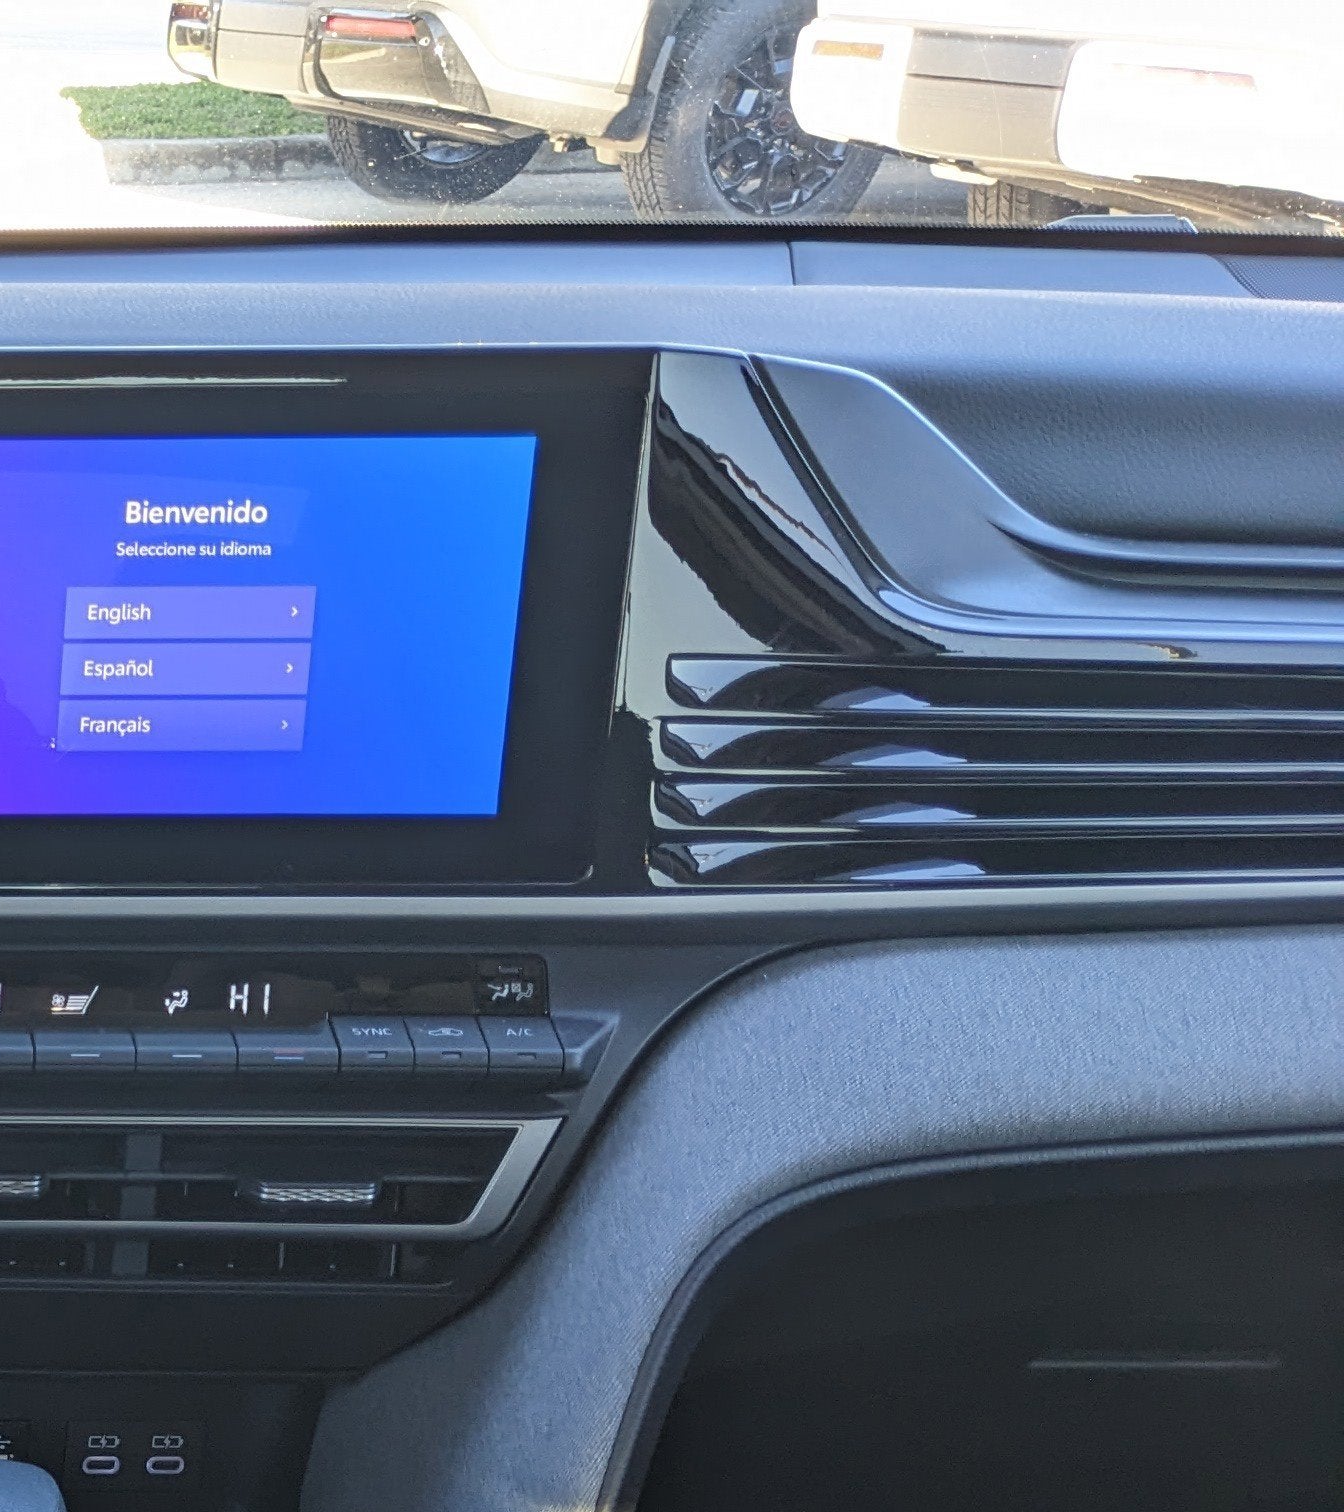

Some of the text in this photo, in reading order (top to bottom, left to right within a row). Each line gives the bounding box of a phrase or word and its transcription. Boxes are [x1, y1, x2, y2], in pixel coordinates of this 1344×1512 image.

[125, 499, 269, 524] Bienvenido
[116, 541, 272, 557] Seleccione su idioma
[87, 603, 152, 625] English
[83, 659, 154, 680] Español
[80, 716, 151, 737] Français
[229, 983, 270, 1016] HI
[351, 1028, 393, 1037] SYNC
[506, 1028, 534, 1037] A/C
